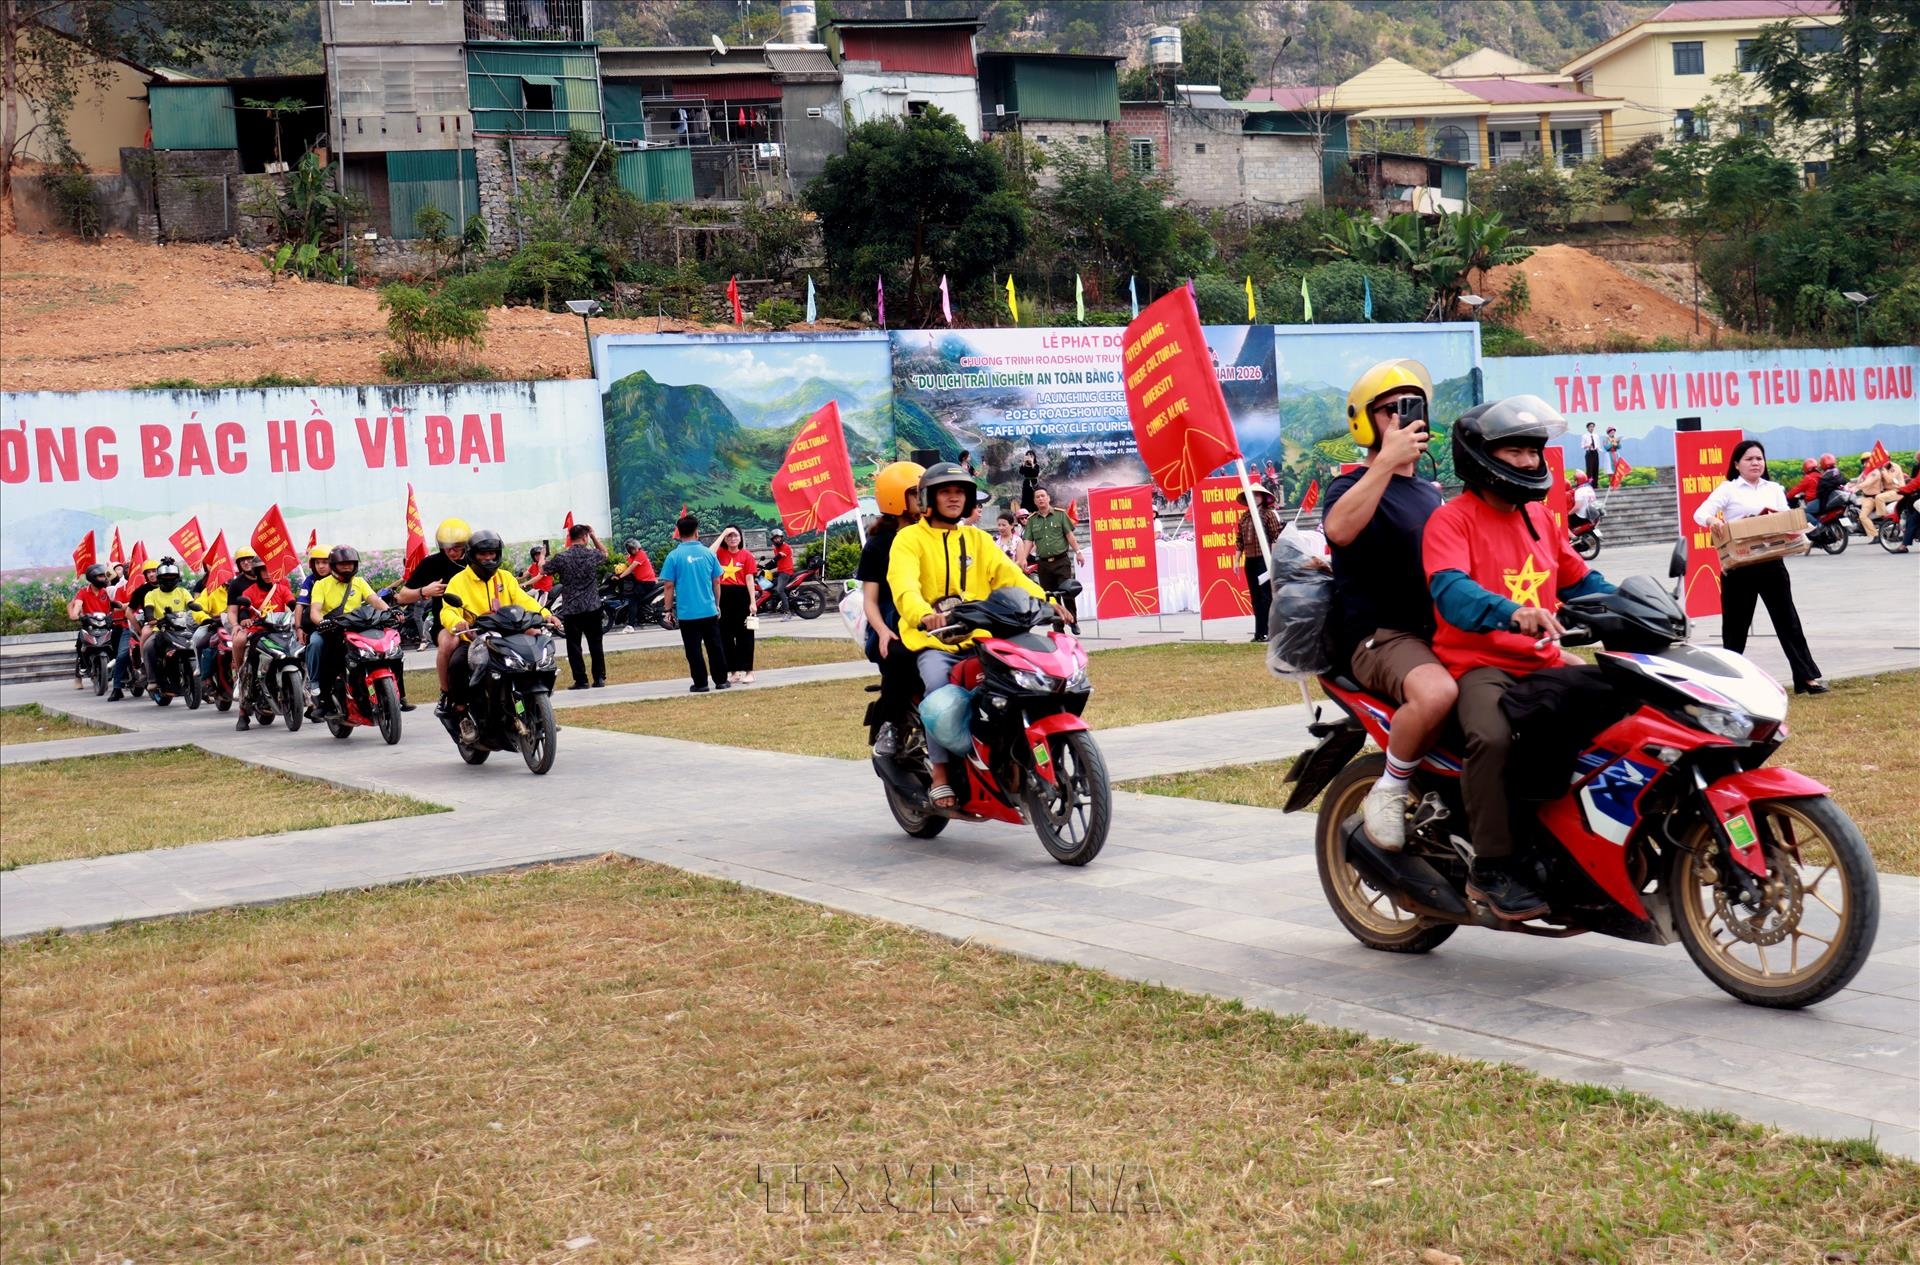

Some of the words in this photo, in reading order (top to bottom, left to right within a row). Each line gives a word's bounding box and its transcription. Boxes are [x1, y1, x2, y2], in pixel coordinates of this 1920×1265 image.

[1140, 322, 1165, 349] QUANG
[1036, 354, 1094, 366] ROADSHOW
[1096, 353, 1121, 365] TRUY
[1127, 365, 1147, 391] WHERE
[1145, 341, 1182, 373] CULTURAL
[1037, 373, 1052, 386] AN
[1237, 366, 1262, 380] 2026
[1142, 374, 1175, 409] DIVERSITY
[1554, 362, 1601, 414] TẤT
[1612, 362, 1646, 411] CẢ
[1651, 365, 1678, 409] VÌ
[1686, 371, 1740, 414] MỤC
[1748, 363, 1800, 405] TIÊU
[1809, 361, 1856, 403] DÂN
[1037, 391, 1098, 404] LAUNCHING
[1098, 391, 1127, 402] CERE
[1005, 409, 1037, 421] 2026
[1039, 407, 1101, 419] ROADSHOW
[1102, 407, 1123, 418] FOR
[1145, 411, 1169, 438] COMES
[1167, 397, 1190, 422] ALIVE
[140, 411, 247, 478] BÁC
[267, 400, 336, 473] HỒ
[354, 405, 408, 469] VĨ
[425, 413, 505, 473] ĐẠI
[1016, 423, 1090, 436] MOTORCYCLE
[797, 434, 829, 452] CULTURAL
[788, 455, 822, 474] DIVERSITY
[788, 478, 812, 492] COMES
[813, 470, 831, 485] ALIVE
[1202, 487, 1224, 503] TUYÊN
[1228, 529, 1237, 546] SẮ
